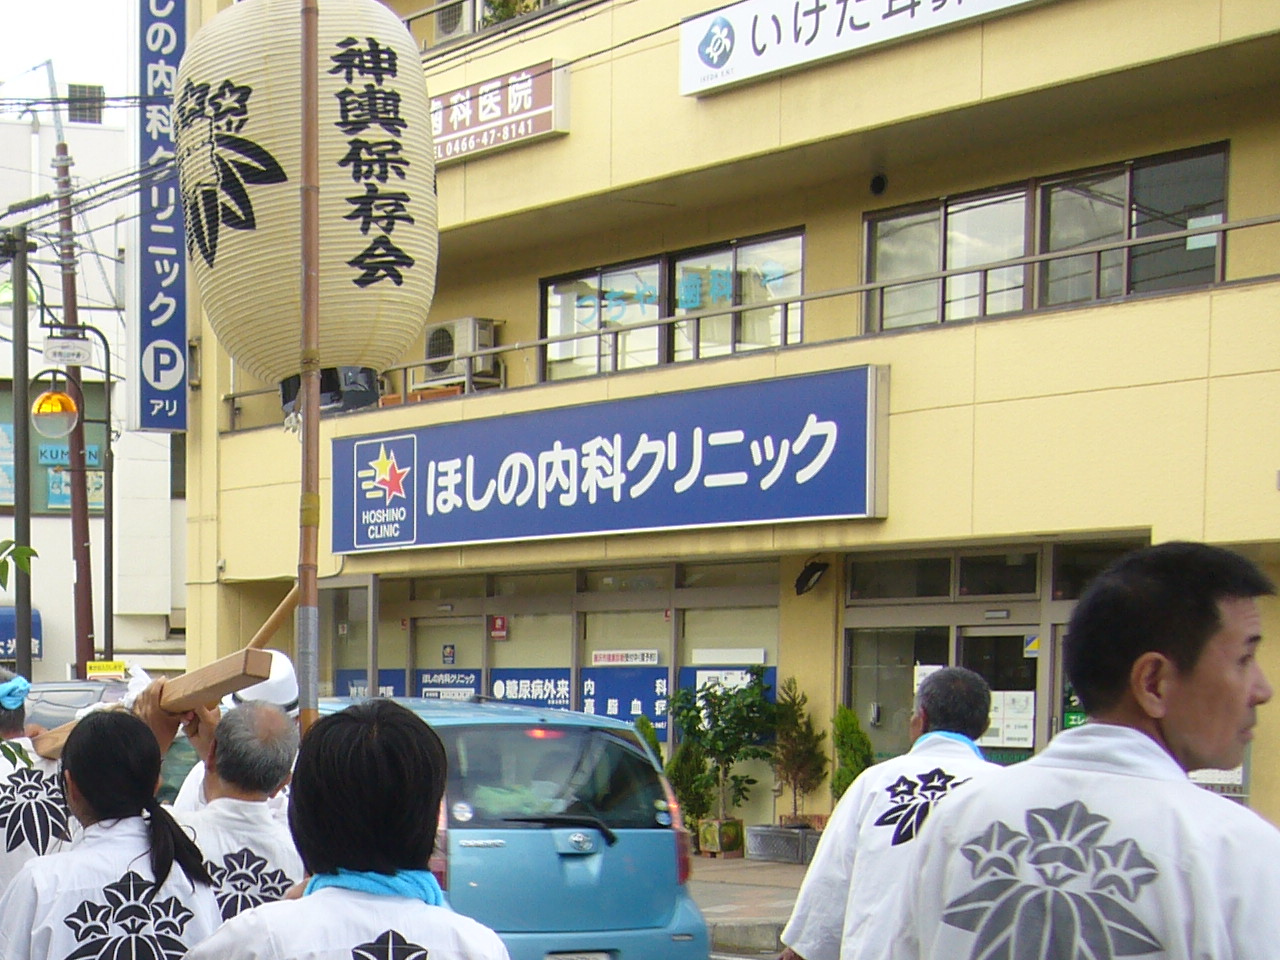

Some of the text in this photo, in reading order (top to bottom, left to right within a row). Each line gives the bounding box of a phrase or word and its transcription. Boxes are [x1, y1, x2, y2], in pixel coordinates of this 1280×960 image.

[326, 36, 415, 288] 神輿保存会
[149, 399, 178, 417] アリ
[39, 450, 99, 461] KUMN
[426, 413, 838, 516] ほしの内科クリニック
[361, 506, 406, 525] HOSHINO
[367, 522, 400, 539] CLINIC
[505, 678, 570, 700] 糖尿病外来
